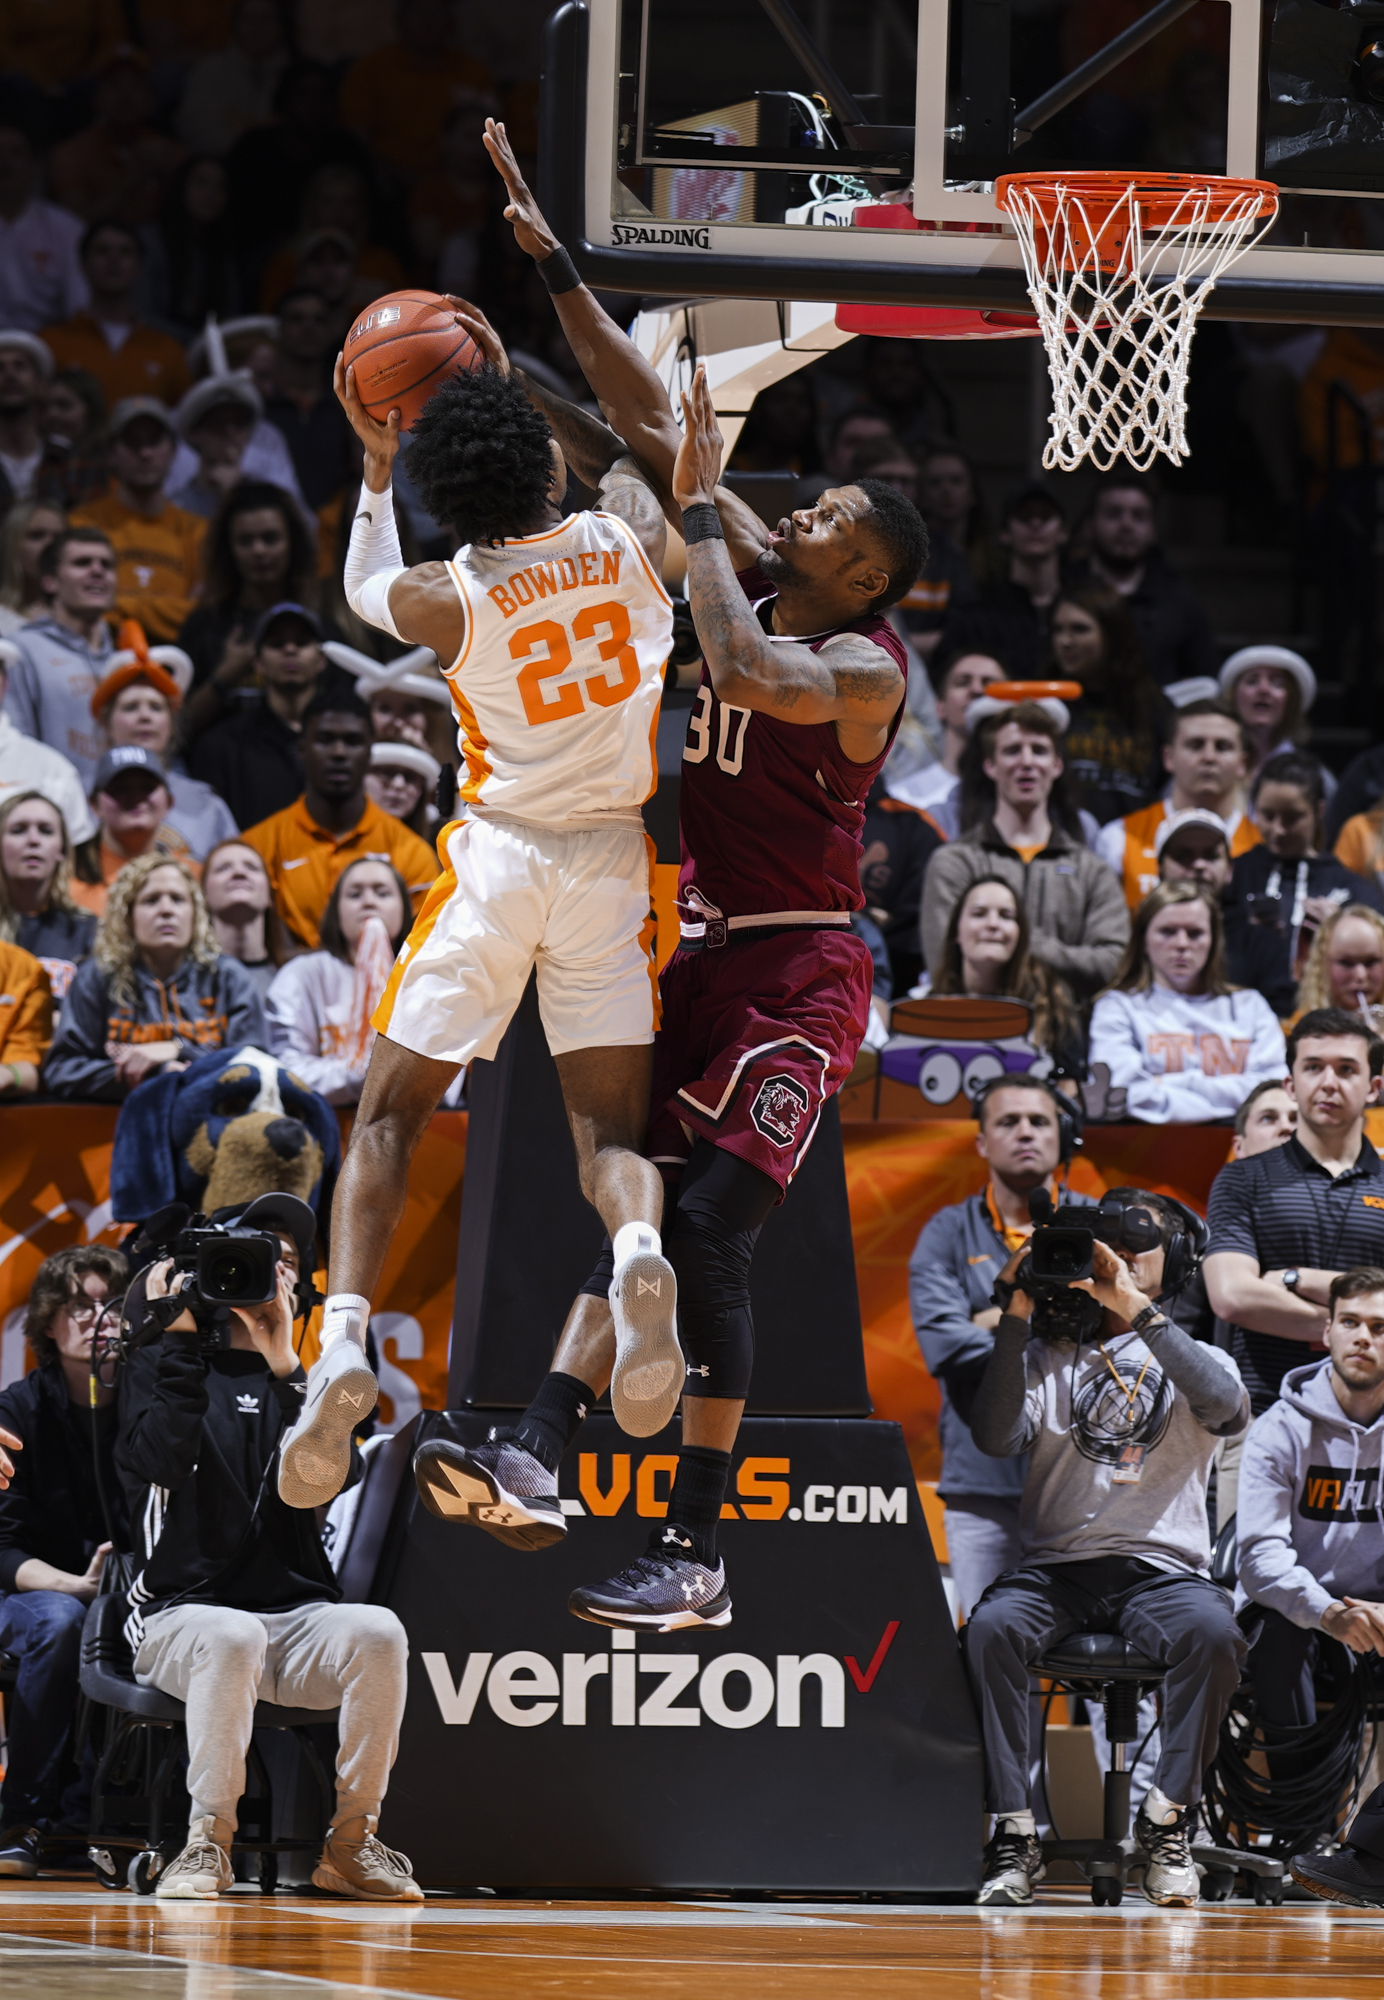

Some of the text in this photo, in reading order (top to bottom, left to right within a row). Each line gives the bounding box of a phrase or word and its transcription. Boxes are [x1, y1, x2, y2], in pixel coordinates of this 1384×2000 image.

[610, 224, 712, 250] SPALDING
[487, 551, 621, 619] BOWDEN
[508, 601, 641, 726] 23
[683, 684, 752, 776] 30
[1147, 1033, 1253, 1077] TN
[421, 1628, 845, 1729] verizon
